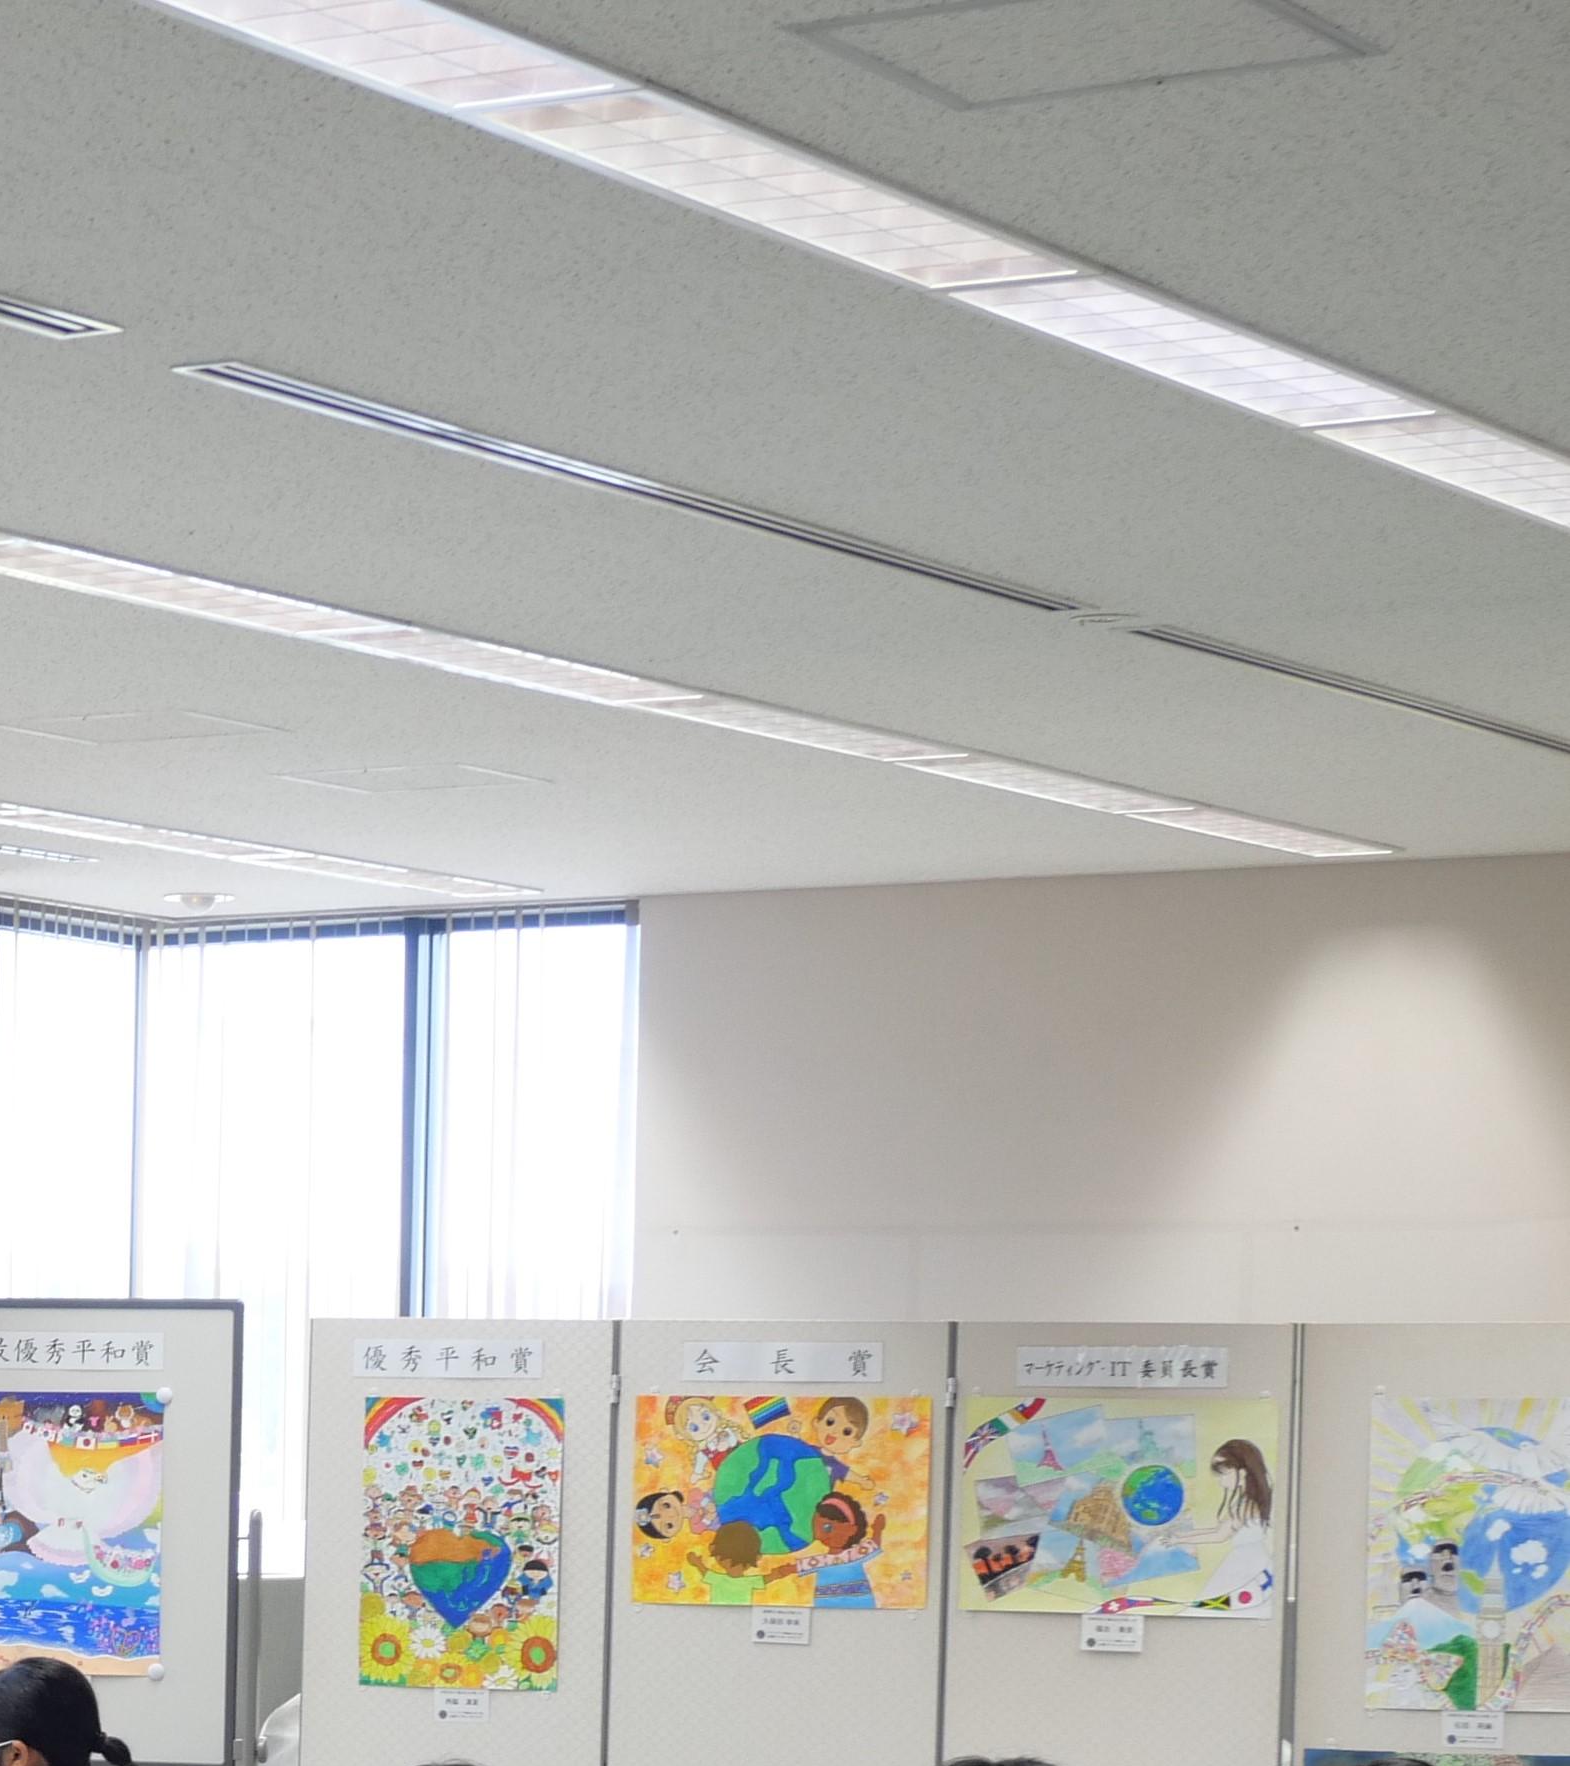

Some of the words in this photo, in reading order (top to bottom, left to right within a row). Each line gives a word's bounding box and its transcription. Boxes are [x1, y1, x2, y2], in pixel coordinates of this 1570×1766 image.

[363, 1345, 533, 1374] 優秀平和賞
